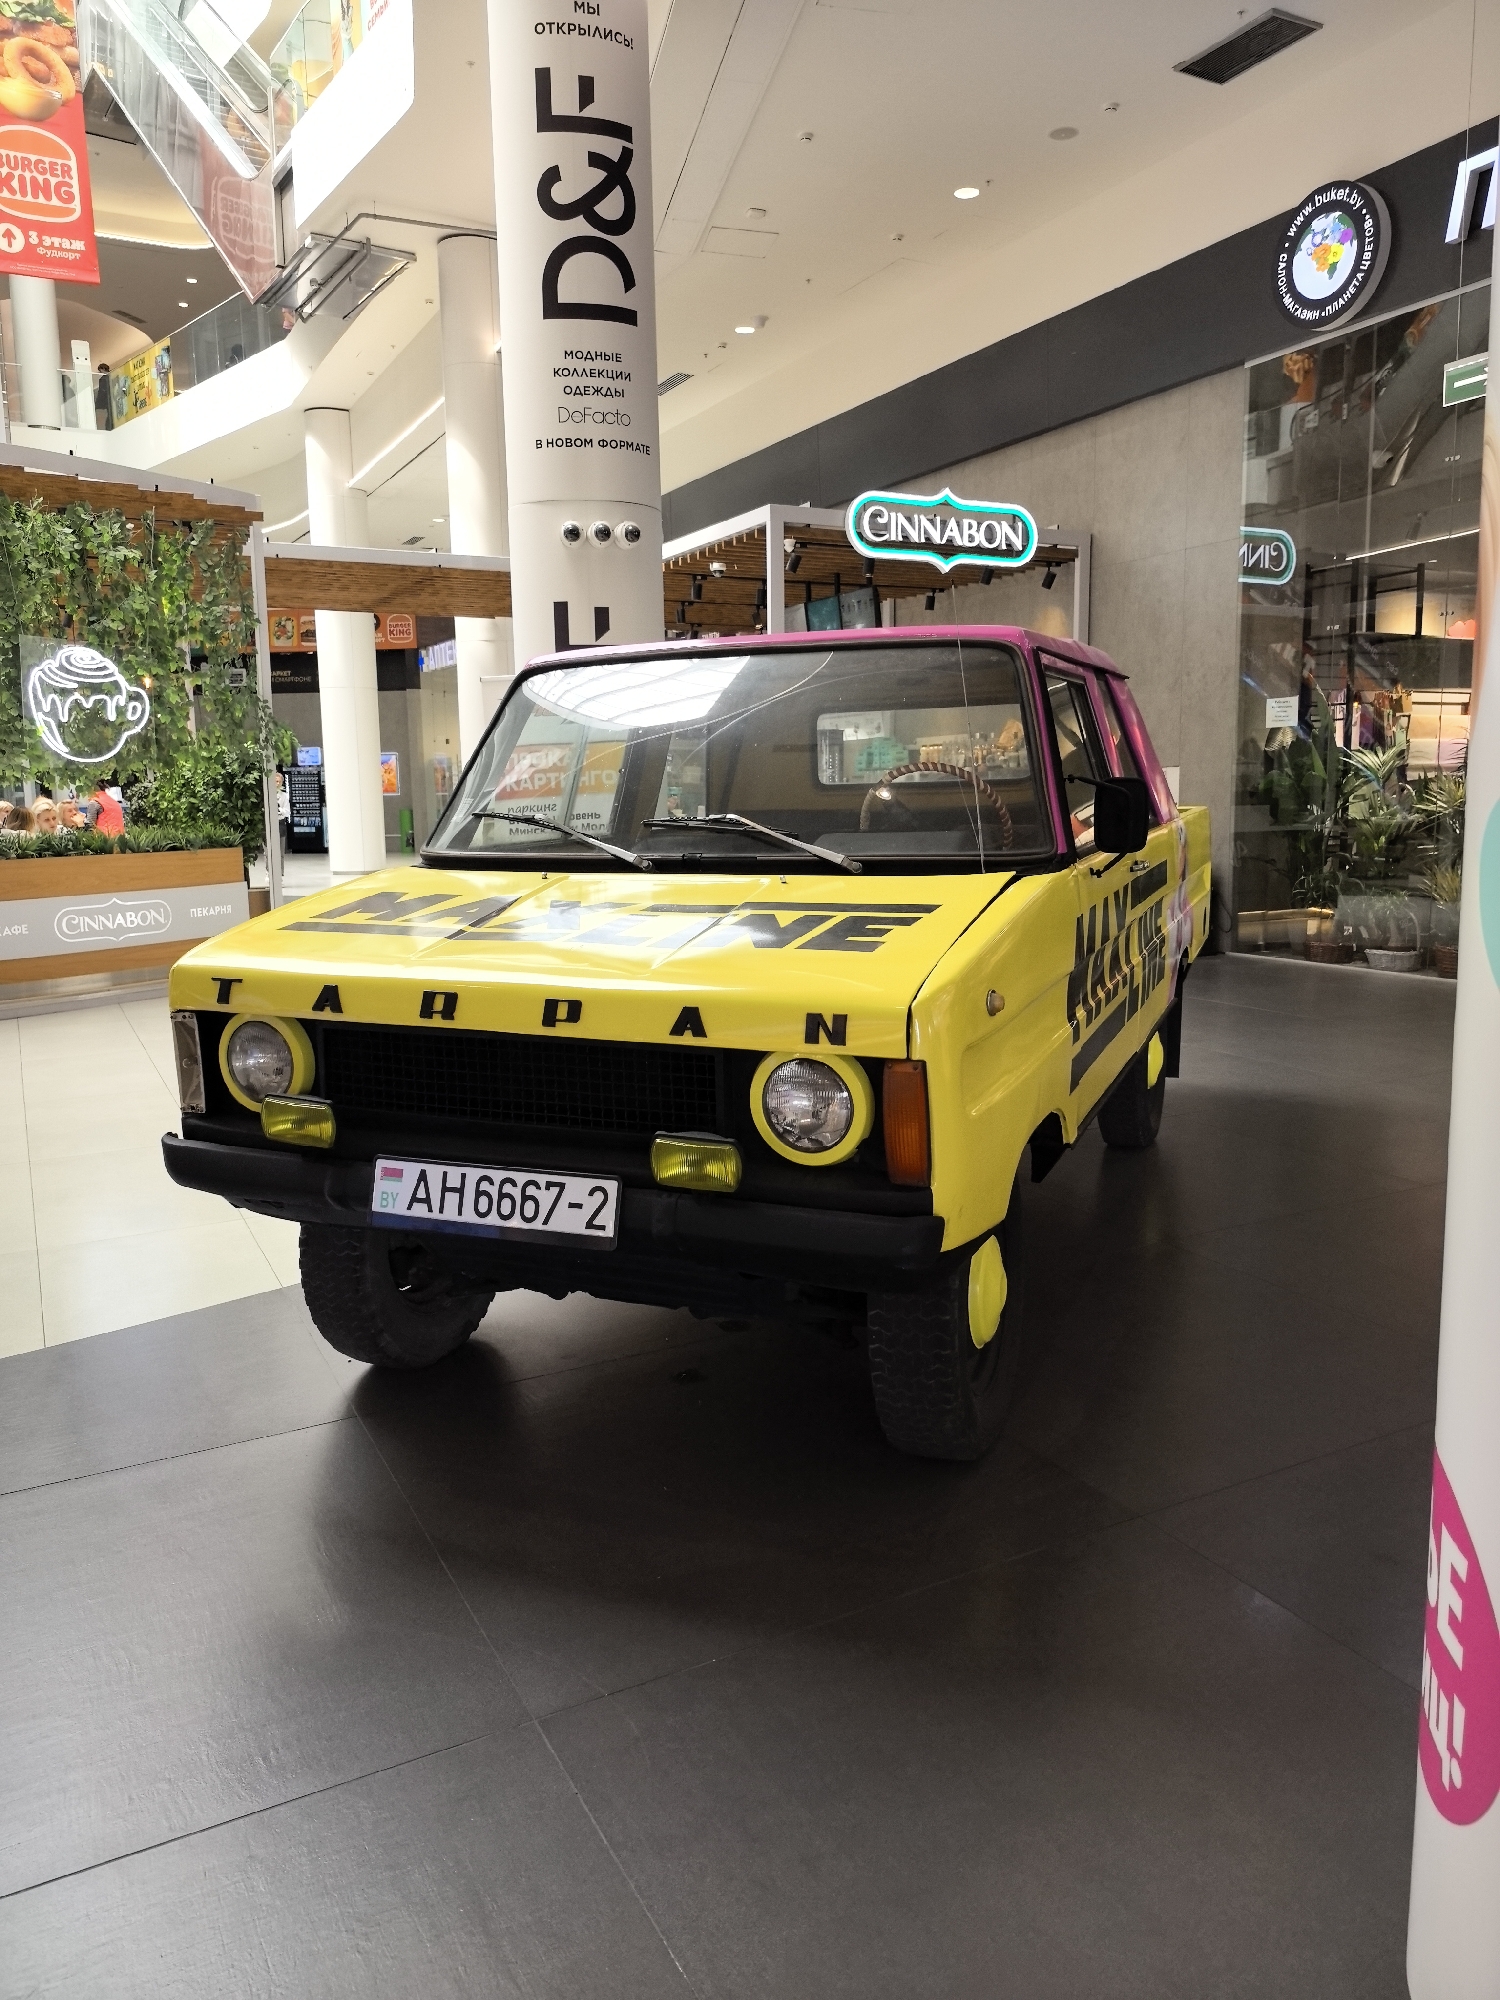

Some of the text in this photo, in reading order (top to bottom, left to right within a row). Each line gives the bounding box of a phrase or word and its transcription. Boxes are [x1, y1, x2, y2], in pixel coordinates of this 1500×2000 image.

[574, 0, 601, 16] МЫ
[534, 22, 634, 50] ОТКРЫЛИСЬ!
[0, 171, 76, 205] KING
[534, 66, 638, 328] D&F
[1287, 187, 1364, 237] www.buket.by
[28, 230, 86, 251] 3 этаж
[1278, 253, 1320, 321] САЛОН-МАГАЗИН
[564, 350, 622, 363] МОДНЫЕ
[553, 367, 632, 382] КОЛЛЕКЦИИ
[563, 385, 625, 398] ОДЕЖДЫ
[557, 406, 632, 427] DeFacto
[535, 437, 651, 456] В НОВОМ ФОРМАТЕ
[862, 505, 1023, 551] CINNABON
[388, 628, 412, 637] KING
[61, 908, 165, 935] CINNABON
[190, 904, 232, 918] ПЕКАРНЯ
[379, 1190, 399, 1209] BY
